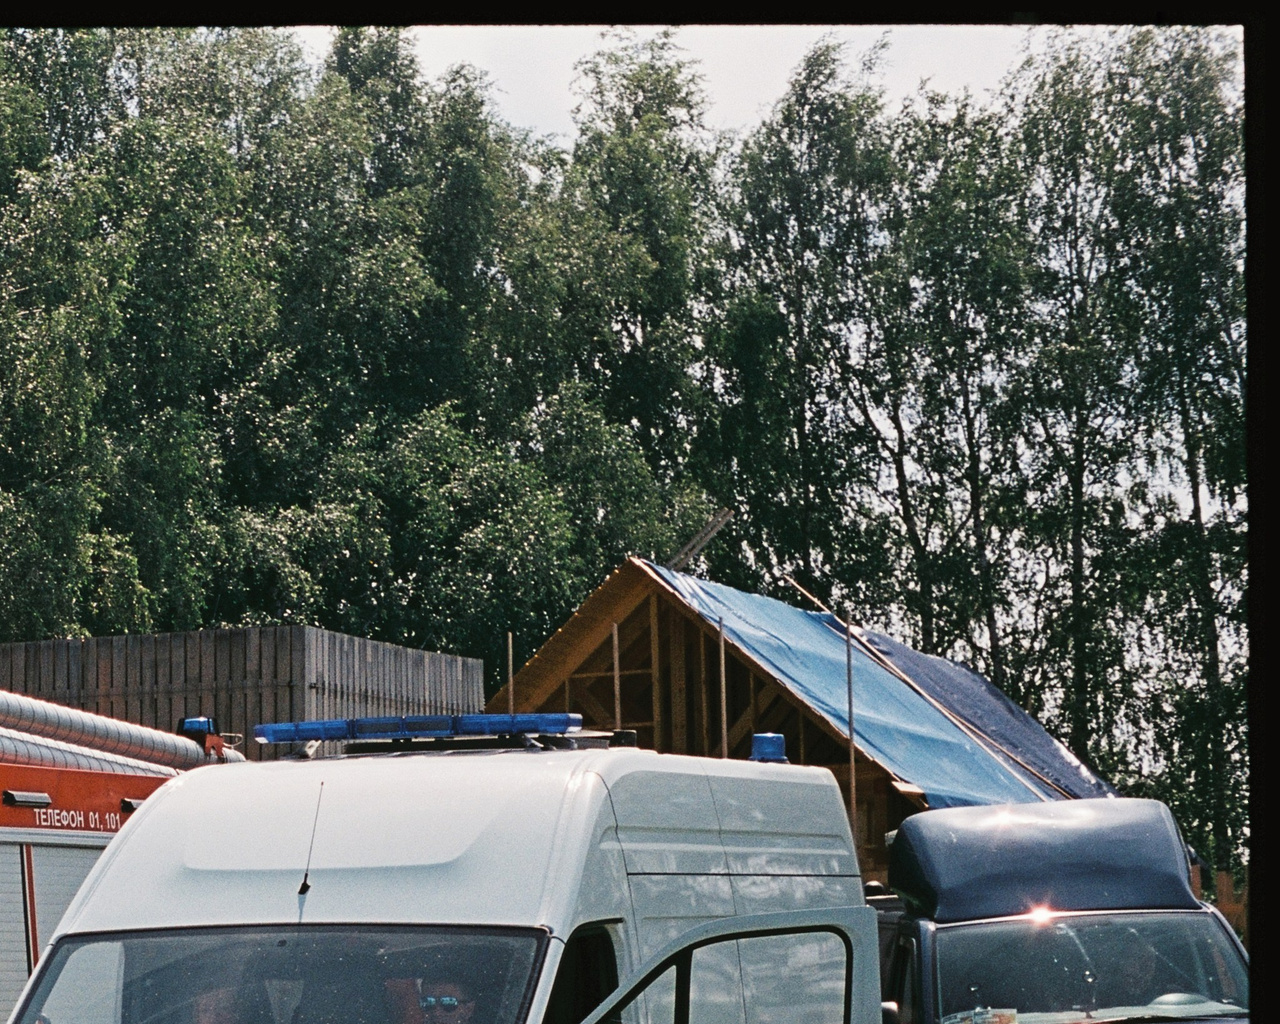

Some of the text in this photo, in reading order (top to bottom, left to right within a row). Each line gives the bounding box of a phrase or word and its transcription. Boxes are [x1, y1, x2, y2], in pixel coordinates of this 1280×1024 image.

[34, 808, 121, 831] ТЕЛЕФОН 01, 101
